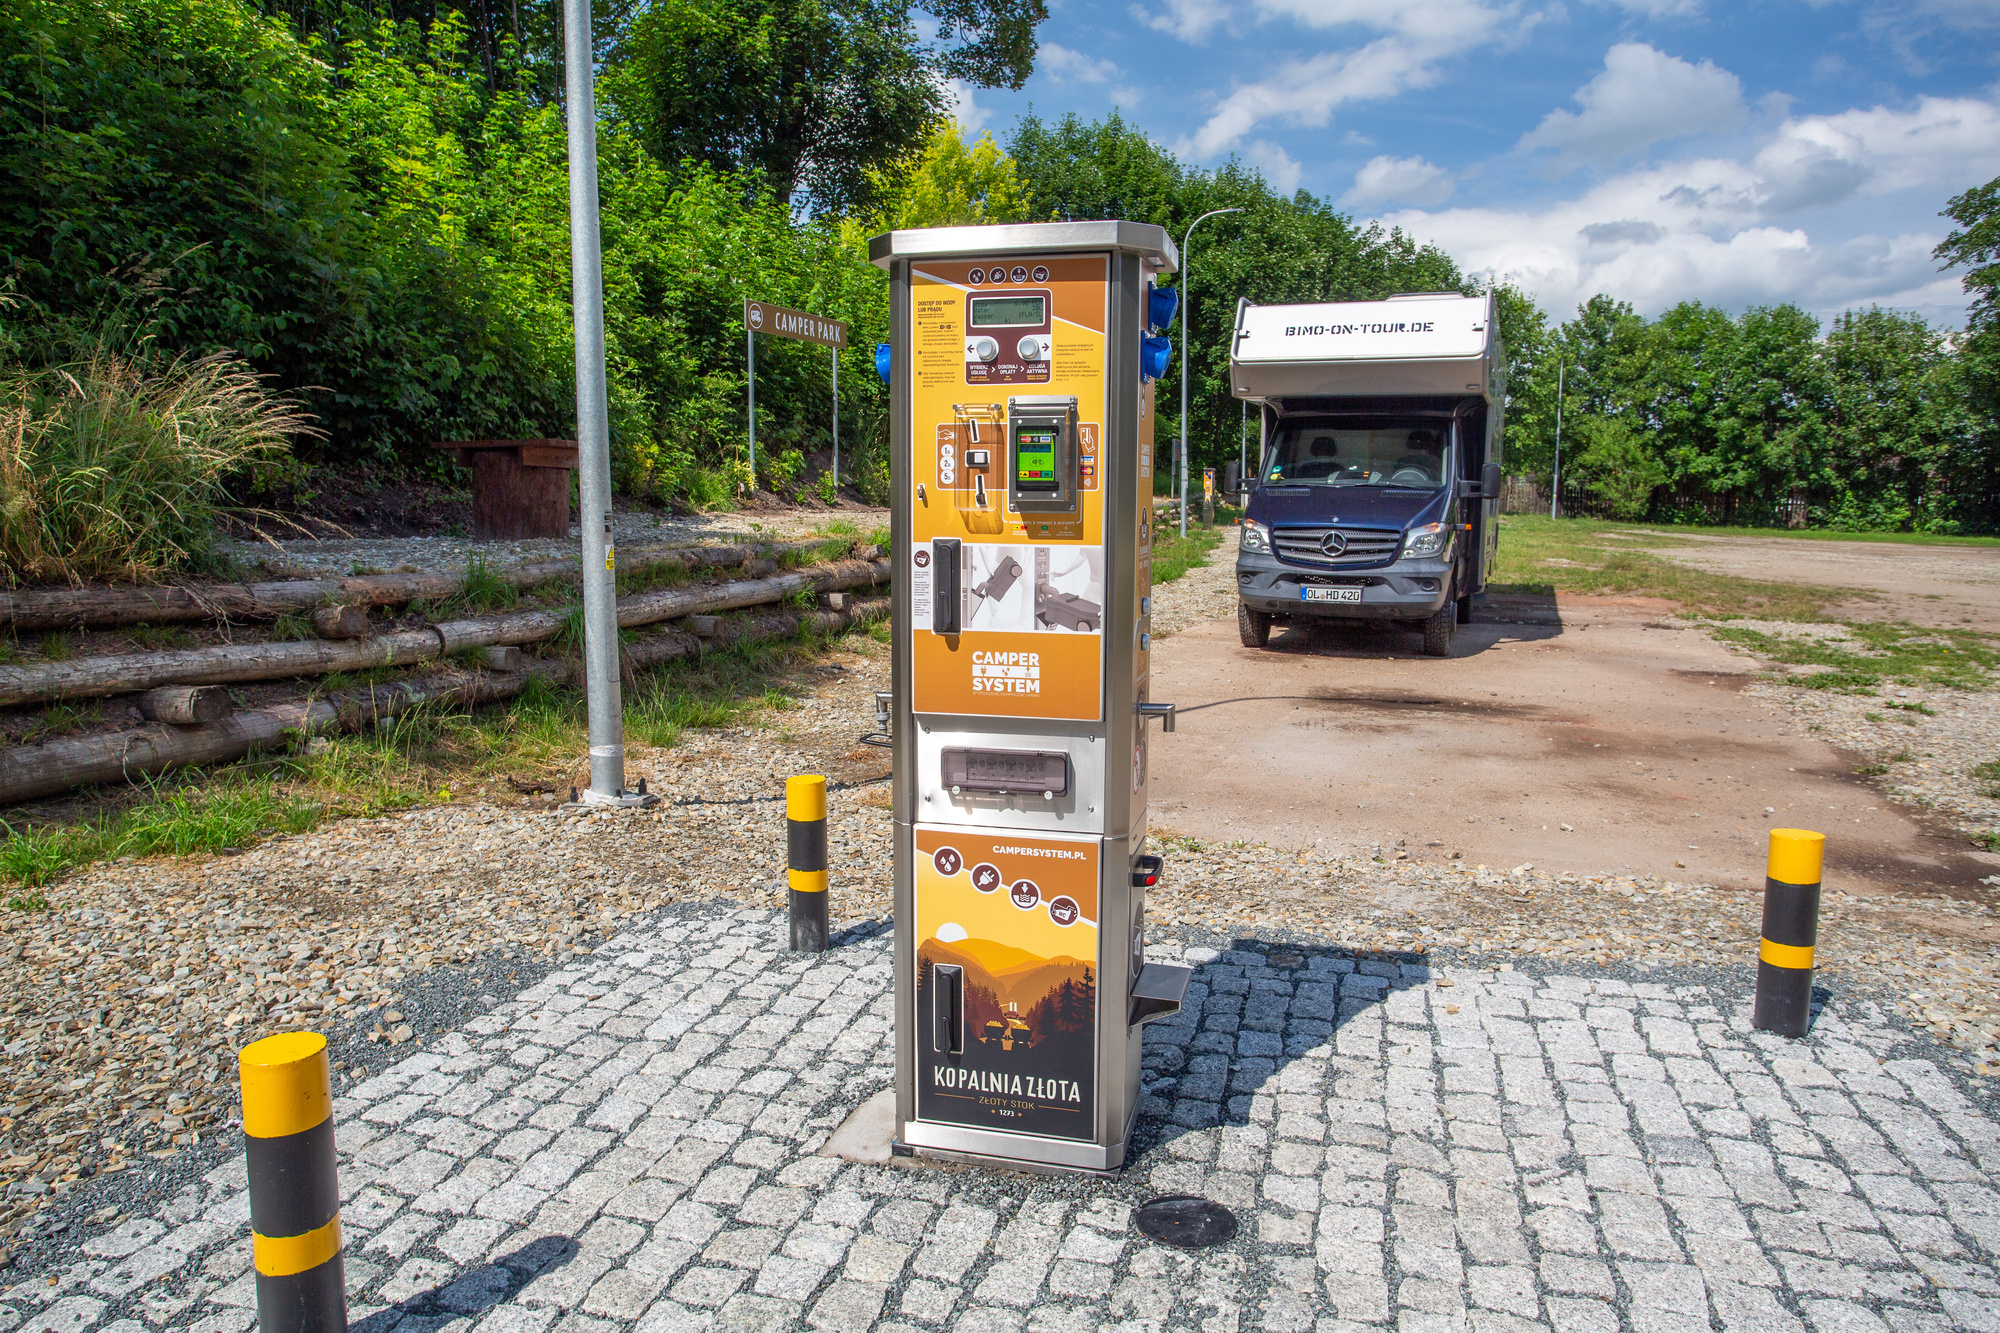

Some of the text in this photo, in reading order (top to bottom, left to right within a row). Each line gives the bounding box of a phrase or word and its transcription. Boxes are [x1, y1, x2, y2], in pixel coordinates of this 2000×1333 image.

[775, 312, 840, 342] CAMPER PARK
[1285, 322, 1435, 336] BIMO-ON-TOUR.DE
[1308, 590, 1360, 600] OL HD 420
[972, 651, 1040, 666] CAMPER
[972, 677, 1040, 693] SYSTEM
[992, 845, 1086, 860] CAMPERSYSTEM.PL
[934, 1065, 1081, 1103] KOPALNIA ZŁOTA
[978, 1096, 1035, 1110] ZŁOTY STOK
